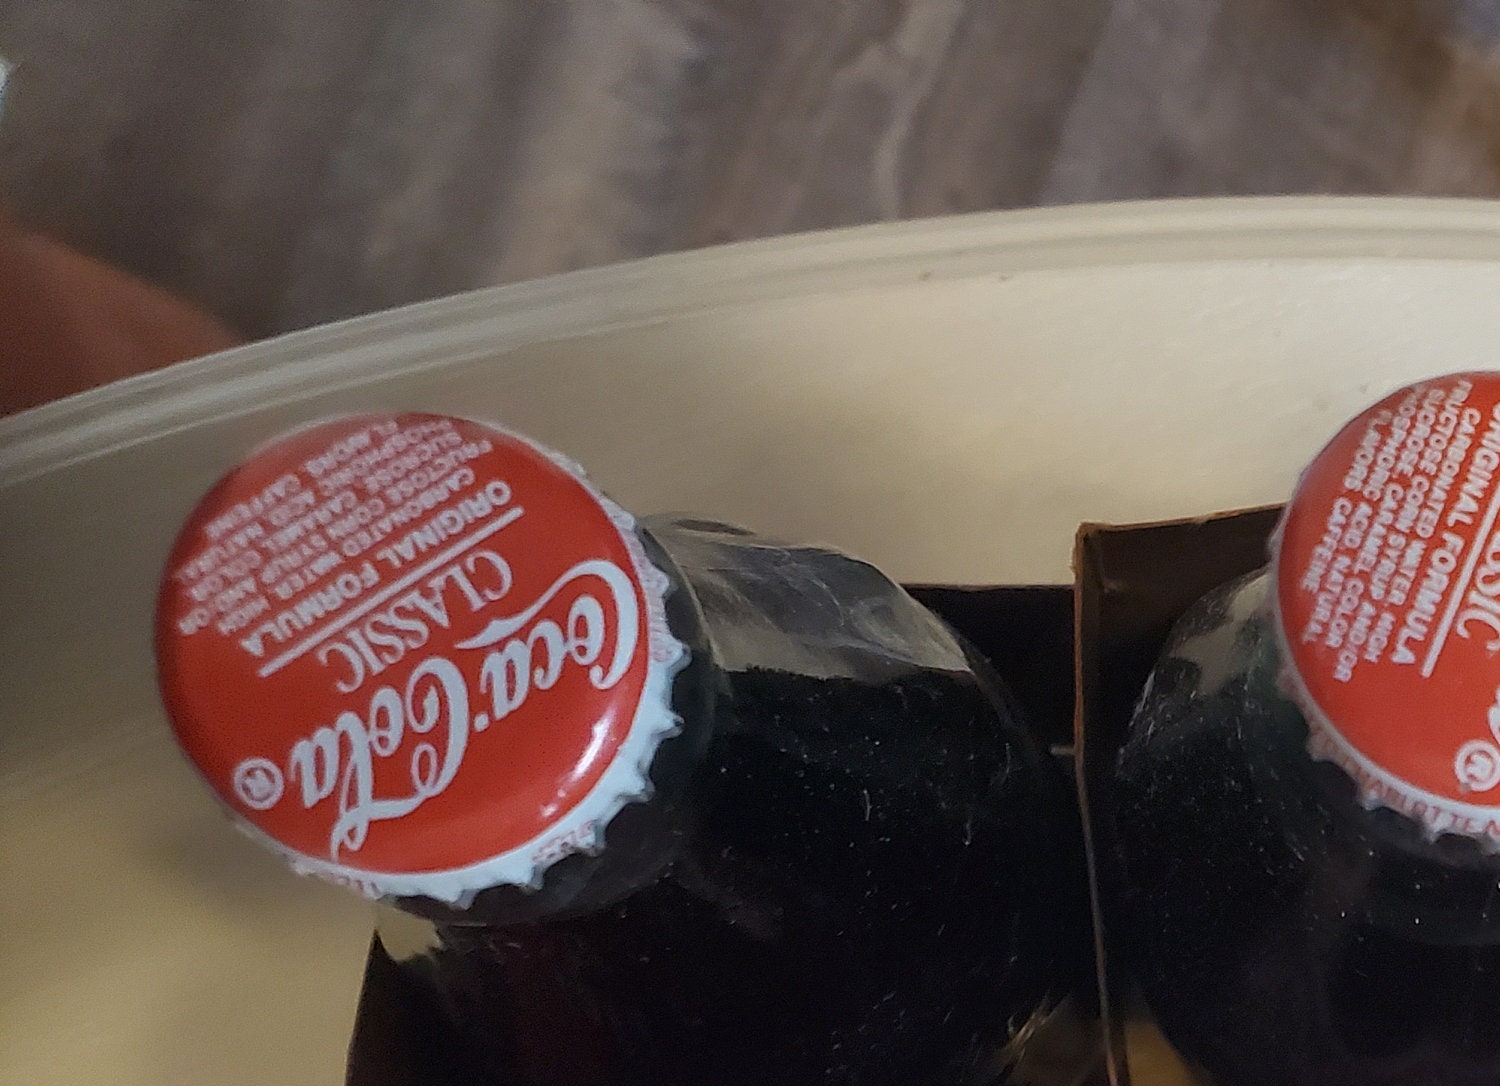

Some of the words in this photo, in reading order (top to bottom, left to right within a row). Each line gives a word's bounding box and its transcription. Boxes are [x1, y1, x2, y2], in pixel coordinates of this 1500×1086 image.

[1408, 405, 1487, 541] CARBONATED
[1415, 376, 1475, 476] FRUCTOSE
[374, 475, 515, 577] ORIGINAL
[1348, 480, 1409, 580] CARAMEL
[1391, 473, 1432, 534] CORN
[235, 557, 382, 664] FORMULA
[1362, 530, 1410, 602] SYRUP
[1384, 528, 1470, 670] FORMULA
[314, 540, 521, 697] CLASSIC
[1361, 610, 1399, 664] HIGH
[287, 561, 647, 862] Coca-Cola
